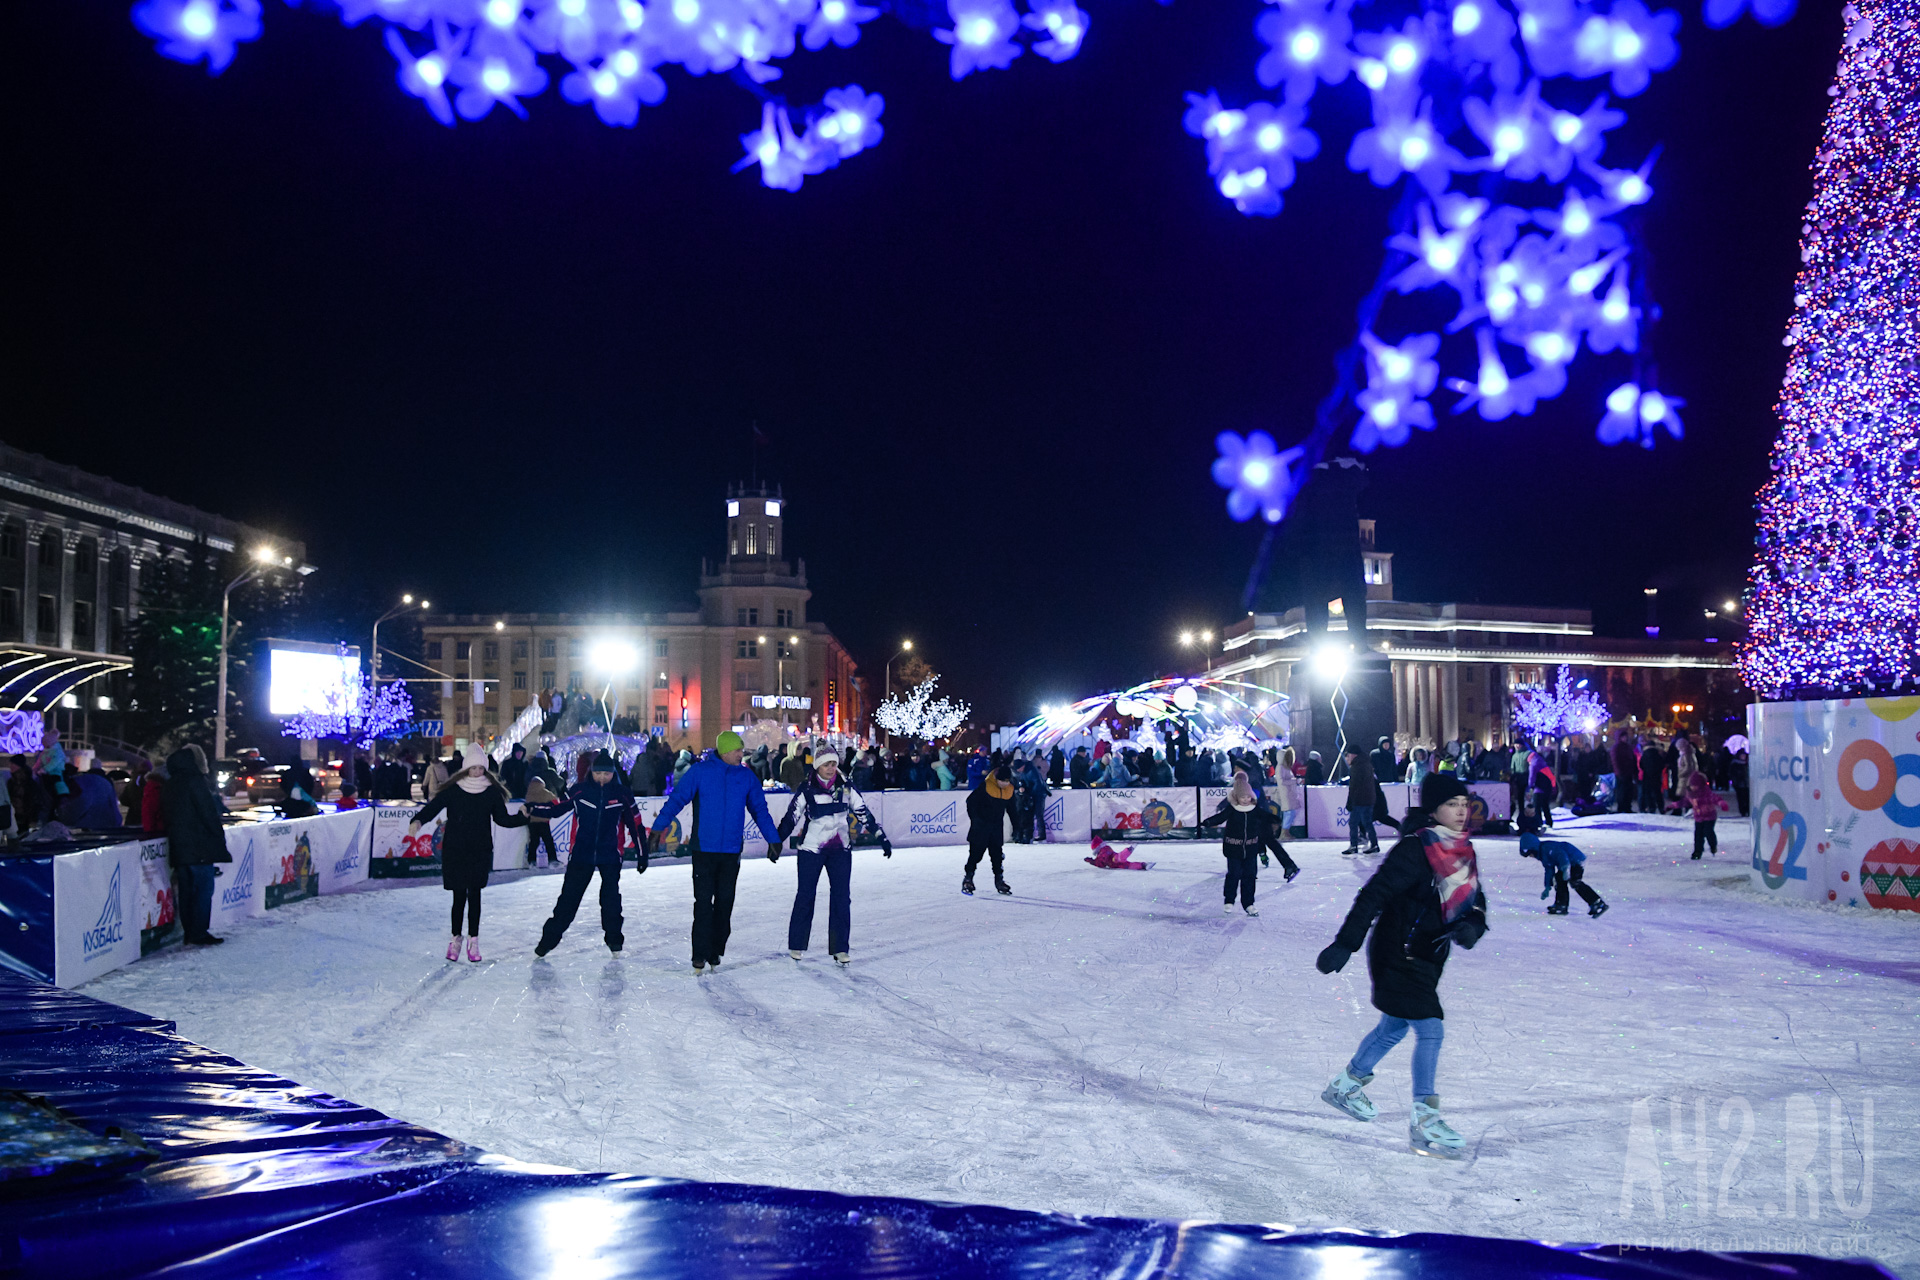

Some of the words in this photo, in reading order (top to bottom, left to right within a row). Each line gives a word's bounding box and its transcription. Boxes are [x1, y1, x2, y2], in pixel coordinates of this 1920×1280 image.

[1096, 790, 1137, 798] КУЗБАСС
[1206, 789, 1228, 797] КУЗБ
[910, 813, 931, 823] 300
[910, 824, 957, 834] КУЗБАСС
[222, 883, 253, 905] КУЗБАСС
[83, 921, 124, 954] КУЗБАСС
